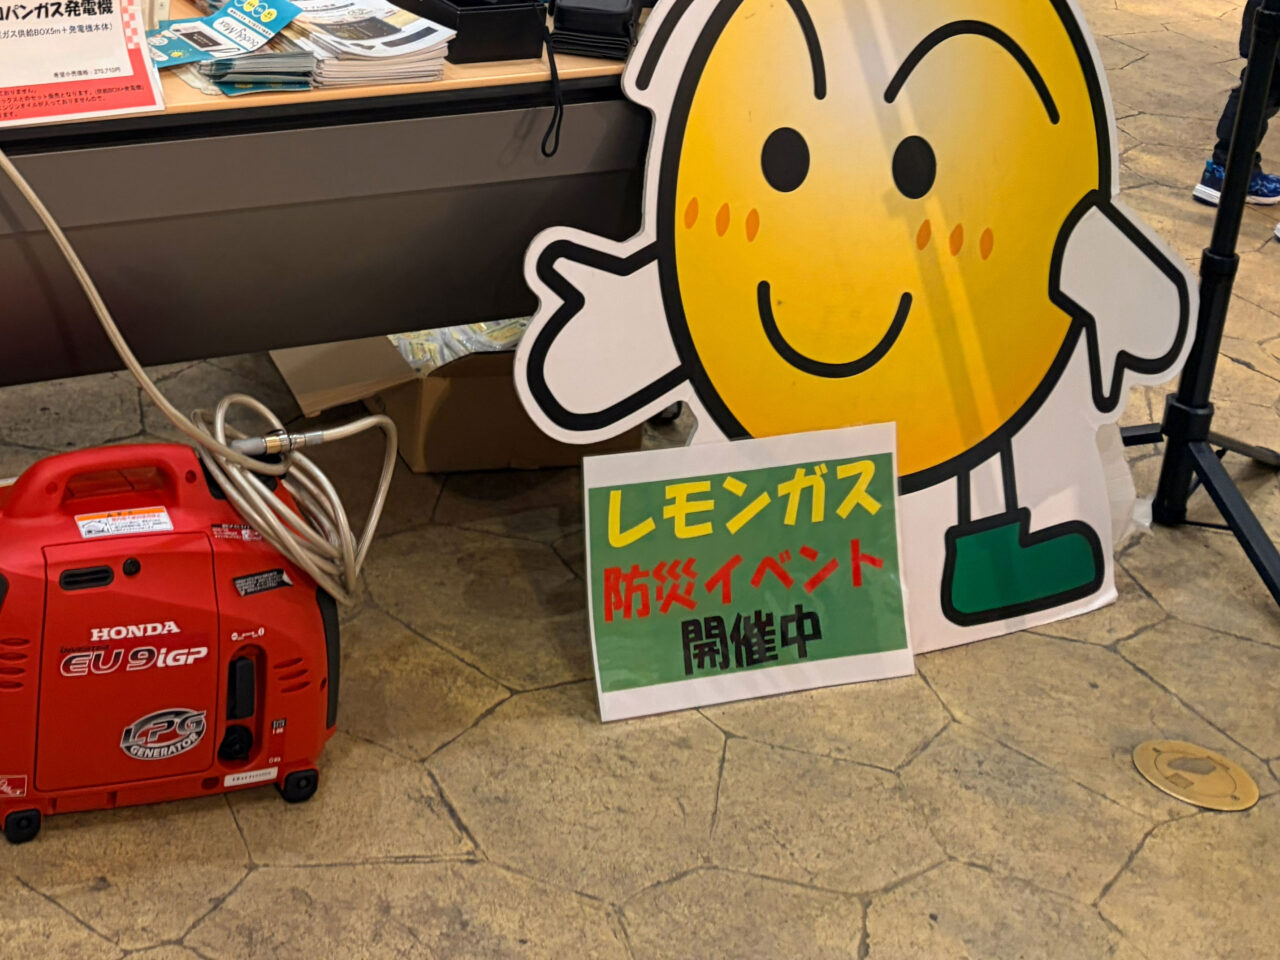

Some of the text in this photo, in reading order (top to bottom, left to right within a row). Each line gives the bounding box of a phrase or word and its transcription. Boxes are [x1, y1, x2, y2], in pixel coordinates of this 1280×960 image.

[607, 459, 883, 548] レモンガス
[603, 538, 885, 623] 防災イベント
[90, 620, 181, 642] HONDA
[681, 604, 823, 676] 開催中
[120, 710, 207, 747] LPG
[130, 732, 199, 758] GENERATOR
